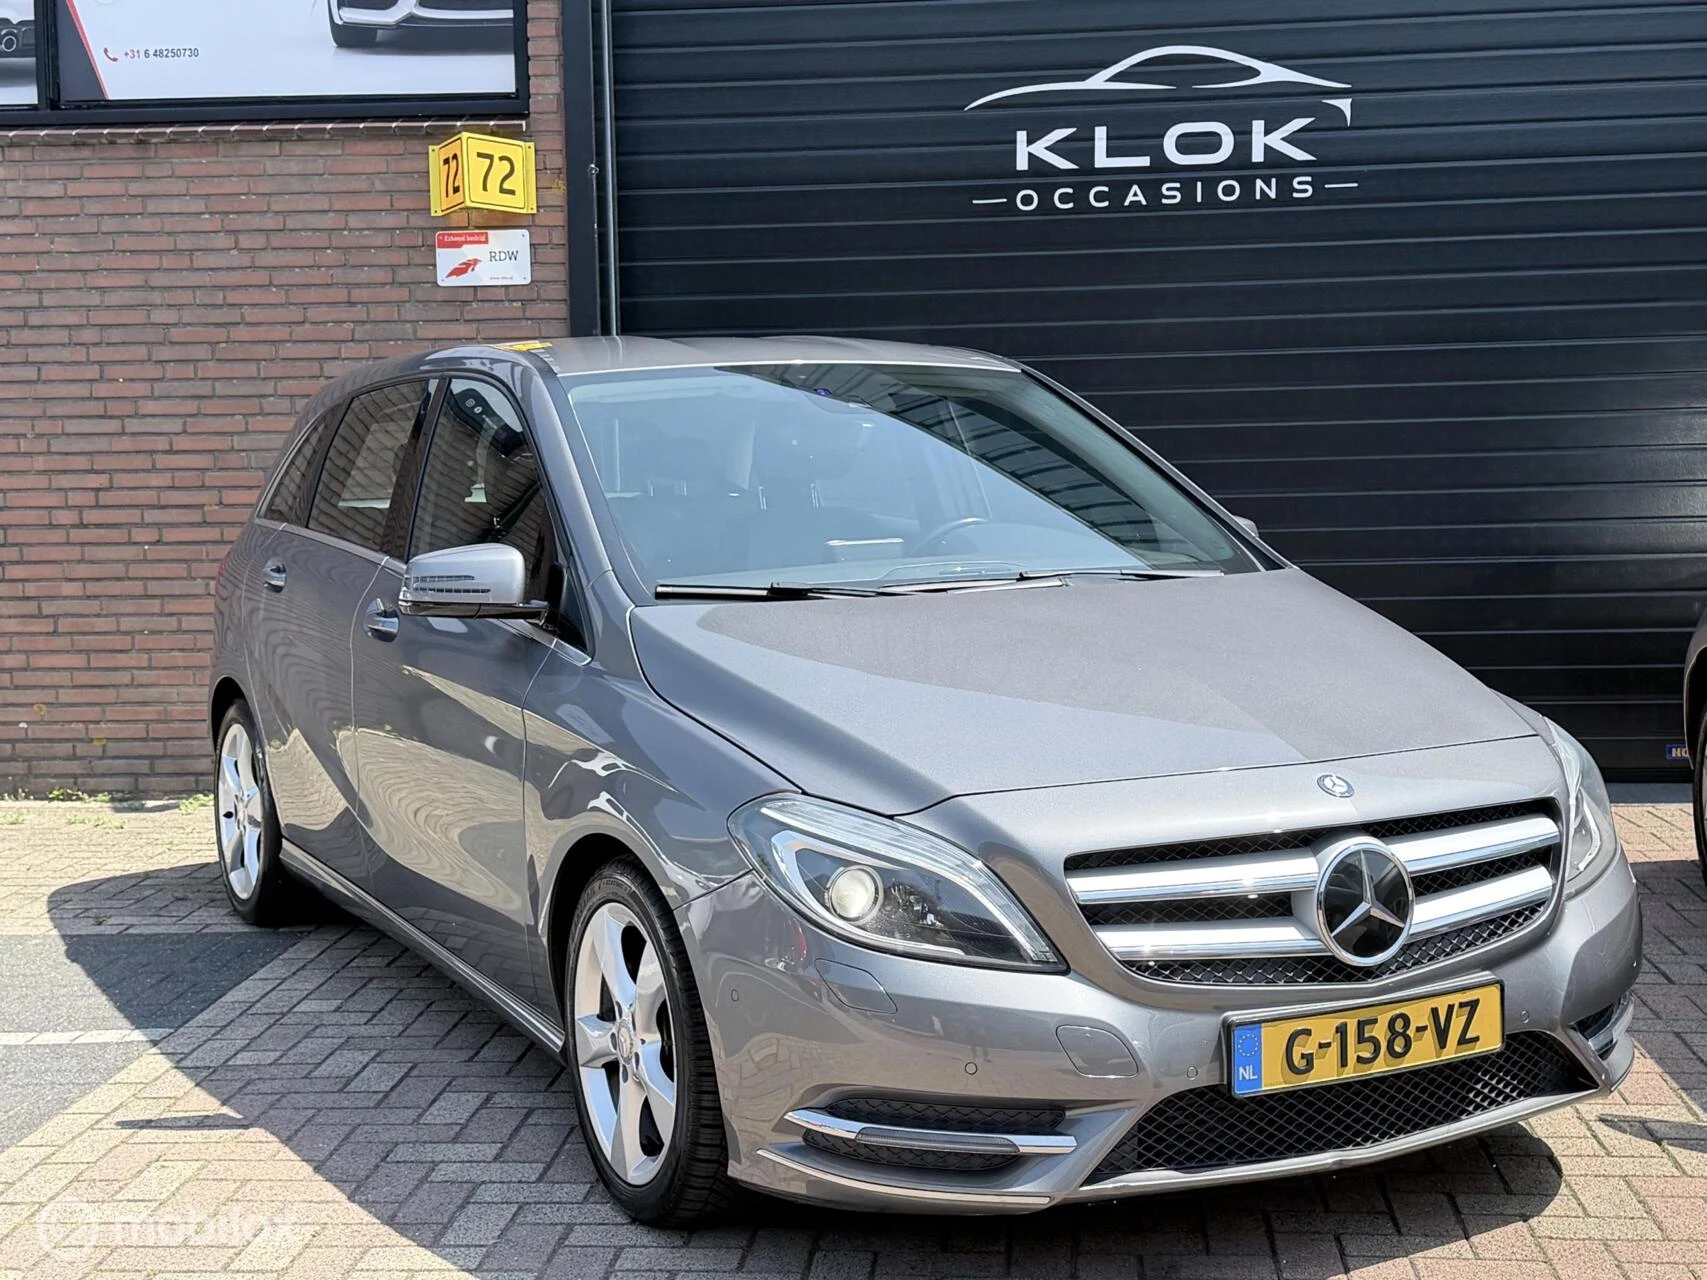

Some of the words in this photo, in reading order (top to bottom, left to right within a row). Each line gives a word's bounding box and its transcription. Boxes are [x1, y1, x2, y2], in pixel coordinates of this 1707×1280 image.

[124, 49, 141, 59] +31
[144, 49, 150, 59] 6
[152, 47, 199, 58] 48250730
[1015, 117, 1318, 171] KLOK
[442, 152, 461, 198] 72
[476, 151, 516, 196] 72
[1015, 176, 1313, 211] OCCASIONS
[489, 250, 519, 262] RDW
[1285, 997, 1480, 1076] G-158-VZ
[1238, 1064, 1258, 1081] NL
